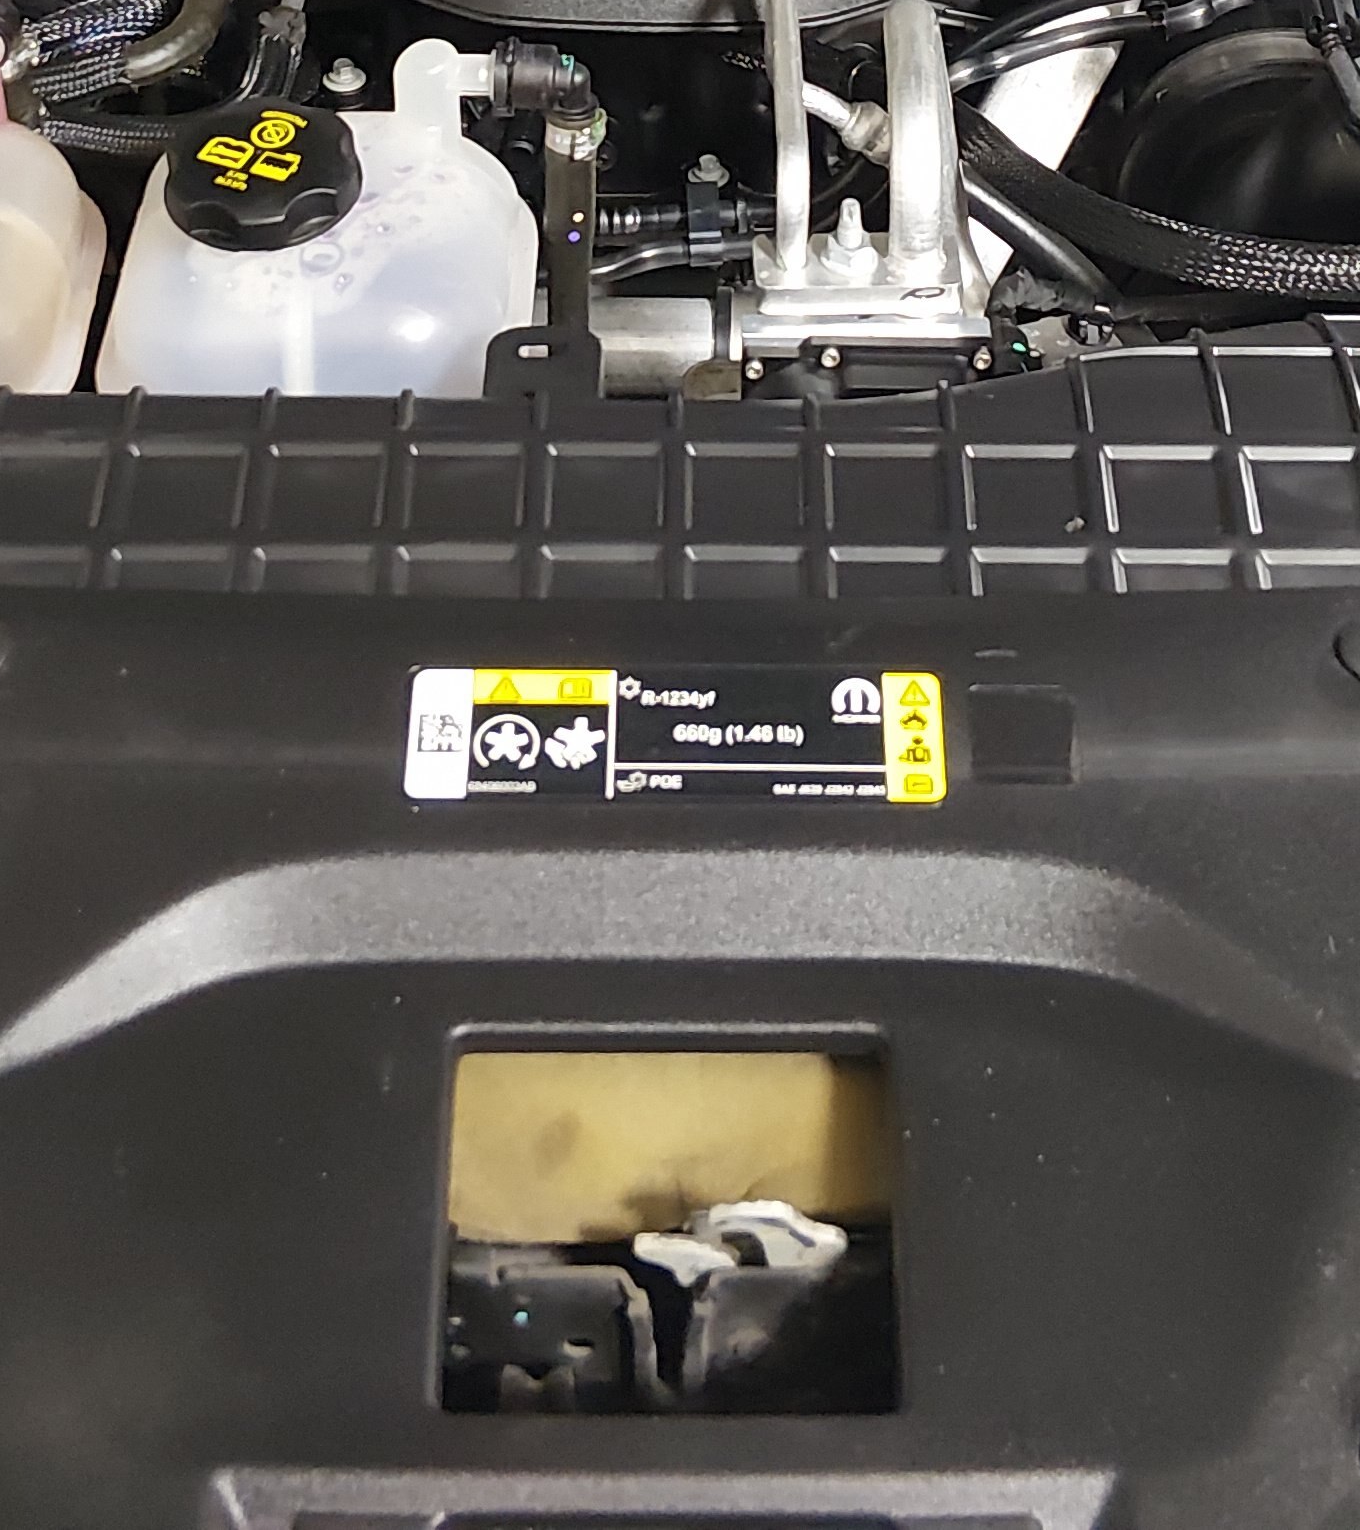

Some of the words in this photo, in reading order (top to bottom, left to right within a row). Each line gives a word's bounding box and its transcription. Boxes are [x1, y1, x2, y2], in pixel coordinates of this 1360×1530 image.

[672, 723, 723, 746] 660g
[725, 724, 774, 747] (1.46
[776, 724, 805, 747] lb)
[649, 774, 683, 790] POE
